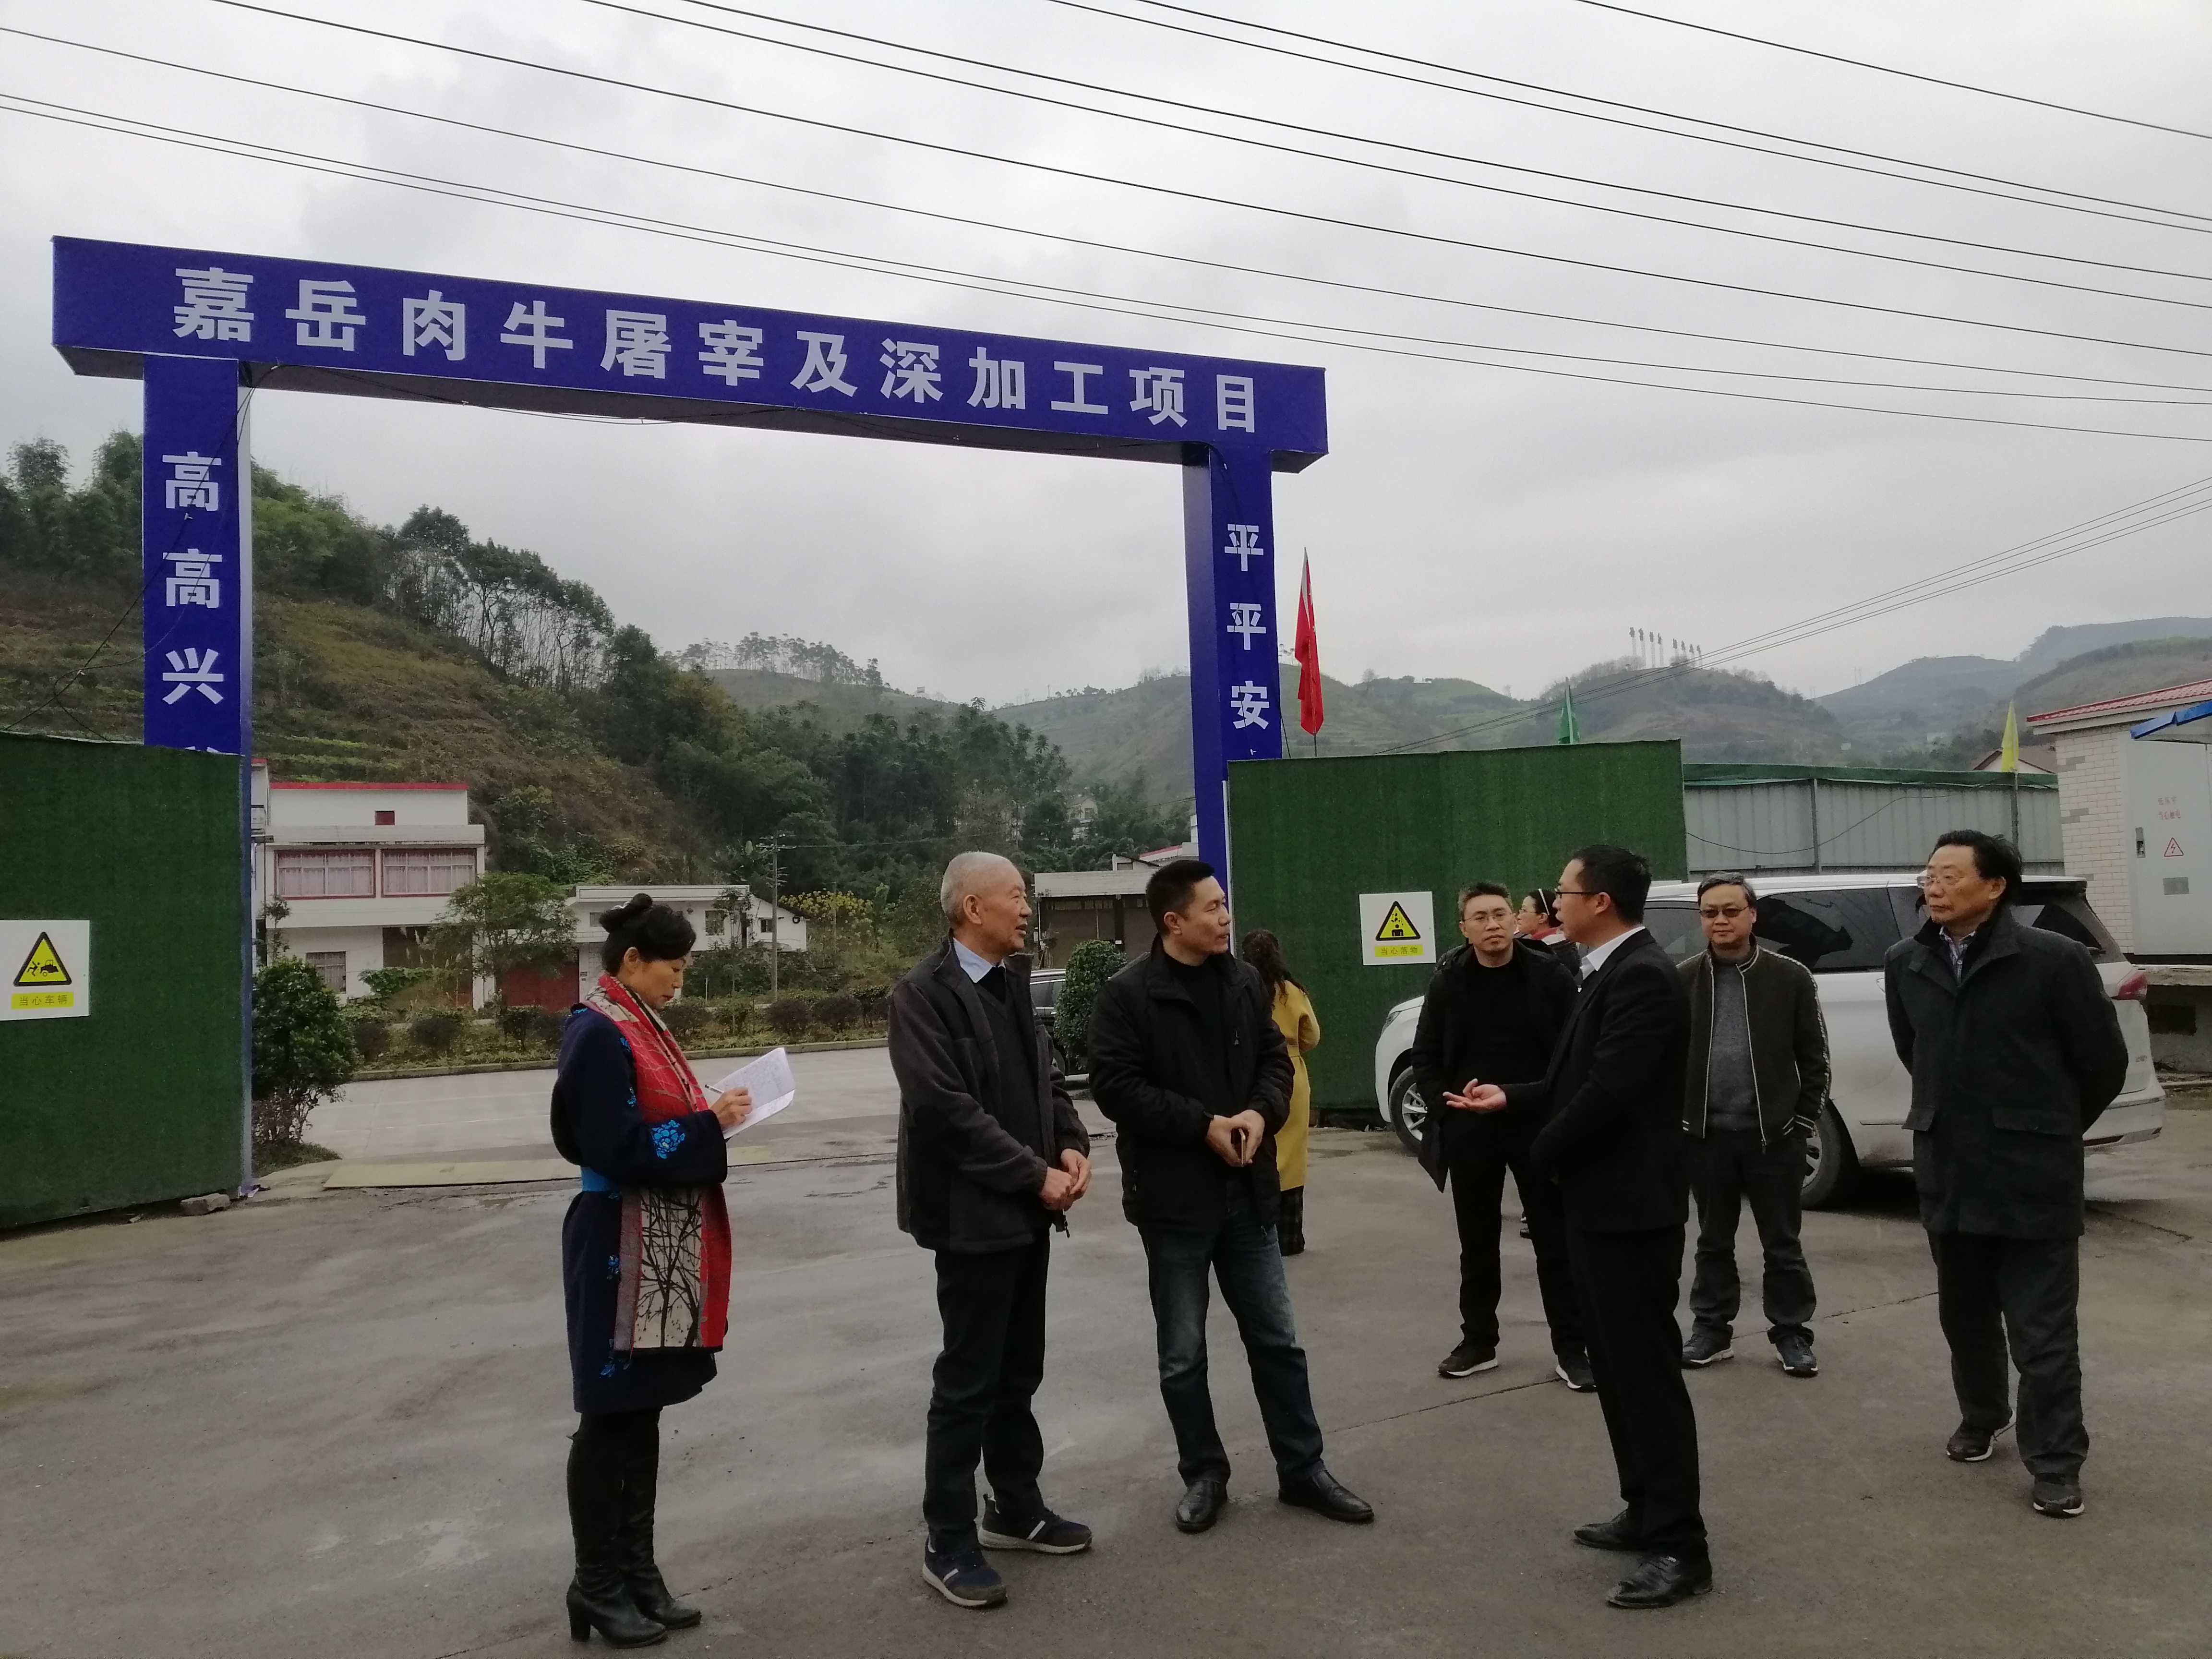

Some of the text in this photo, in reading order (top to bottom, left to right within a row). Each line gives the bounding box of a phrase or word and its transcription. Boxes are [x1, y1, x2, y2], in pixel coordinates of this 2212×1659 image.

[173, 266, 1255, 433] 嘉岳肉牛屠宰及深加工项目
[162, 451, 224, 753] 高高兴
[1224, 524, 1270, 730] 平平安
[19, 994, 68, 1006] 当心车辆
[1381, 946, 1418, 956] 当心落物
